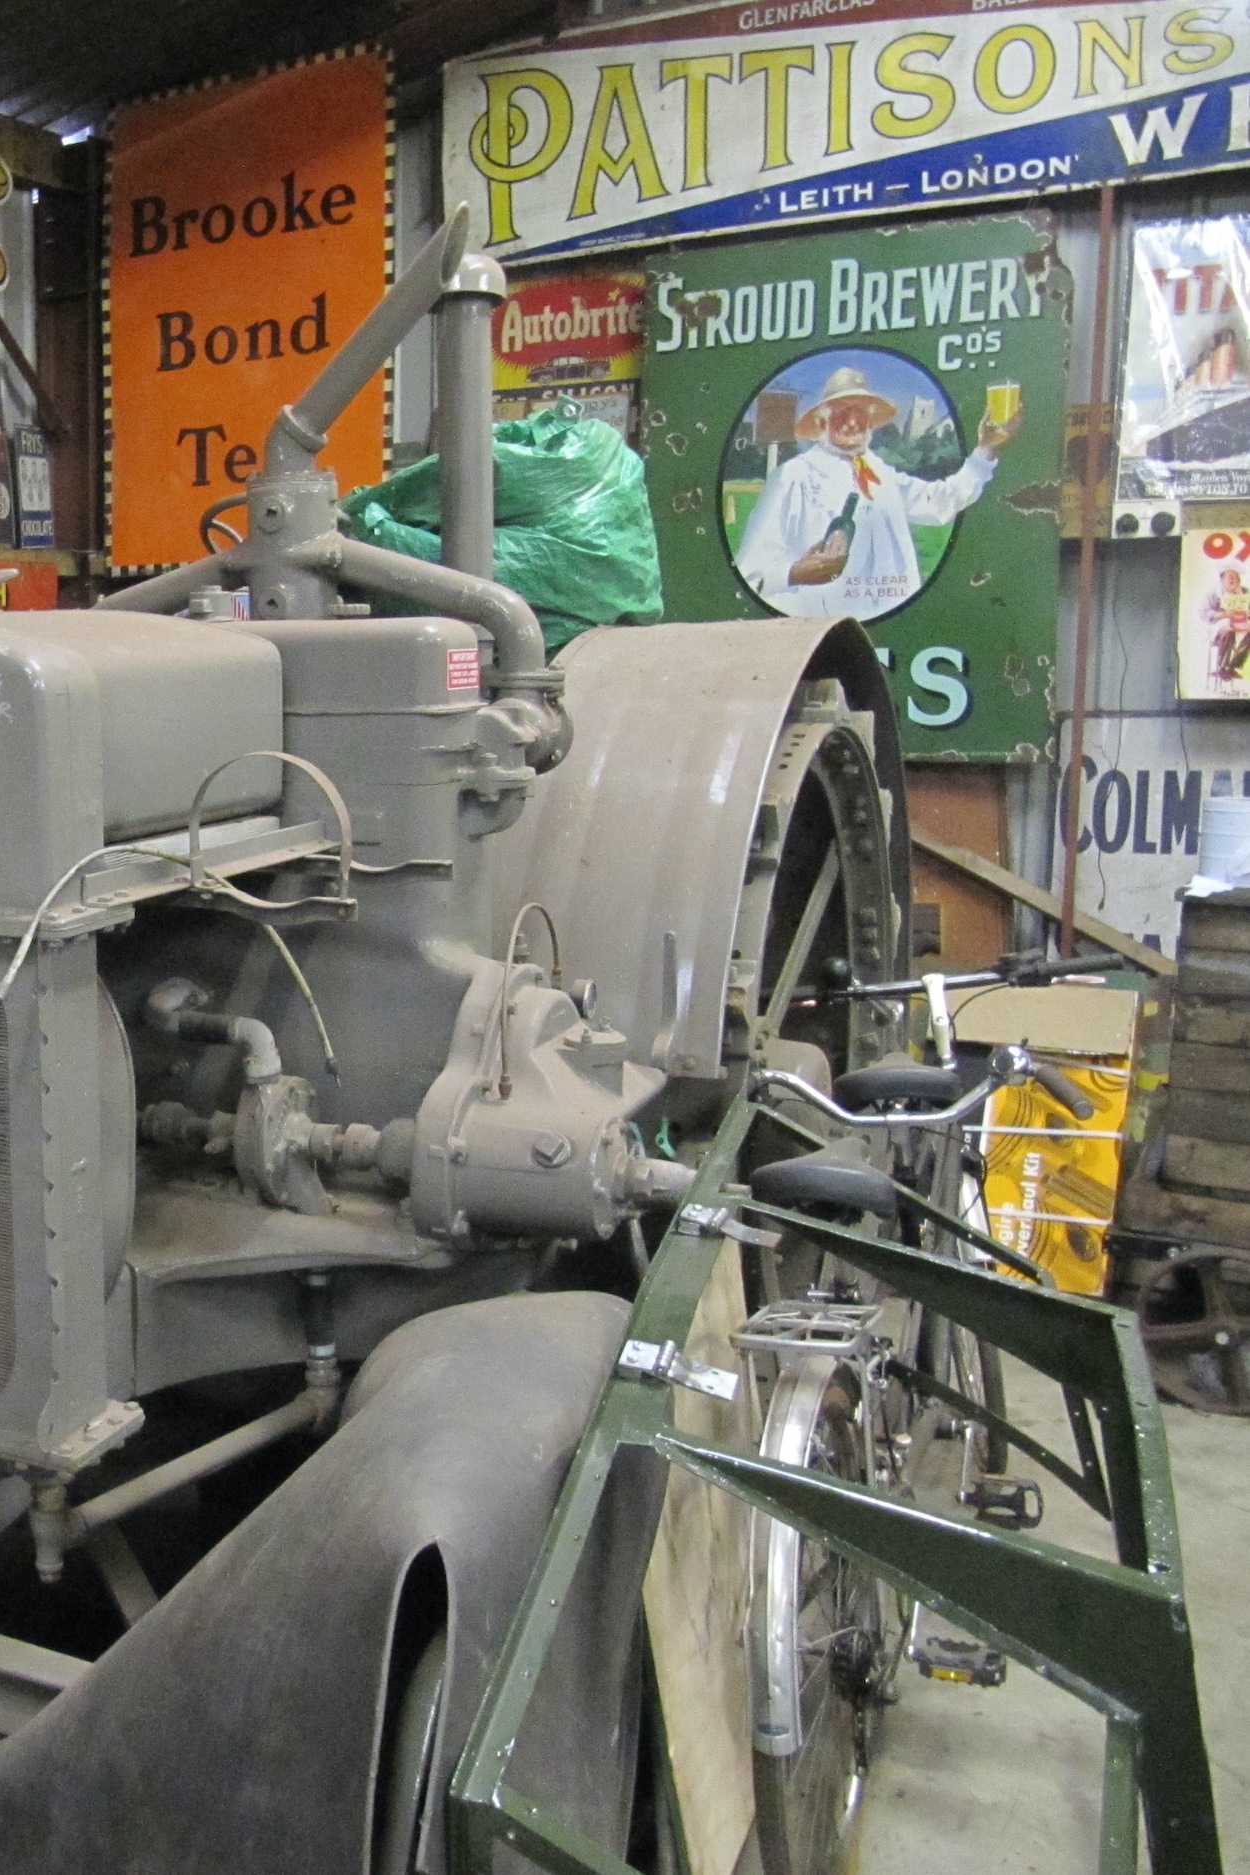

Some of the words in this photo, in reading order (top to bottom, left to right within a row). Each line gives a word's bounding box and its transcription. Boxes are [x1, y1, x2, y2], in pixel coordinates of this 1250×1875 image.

[469, 7, 1235, 249] PATTISONS
[128, 170, 357, 259] Brooke
[779, 181, 874, 213] LEITH
[155, 291, 331, 373] Bond
[501, 296, 645, 354] Autobrite
[656, 276, 816, 353] STROUD
[827, 256, 1047, 336] BREWERY
[176, 423, 258, 487] Te
[863, 576, 908, 586] CLEAR
[1059, 753, 1250, 855] COLM
[1021, 1151, 1042, 1177] Kit
